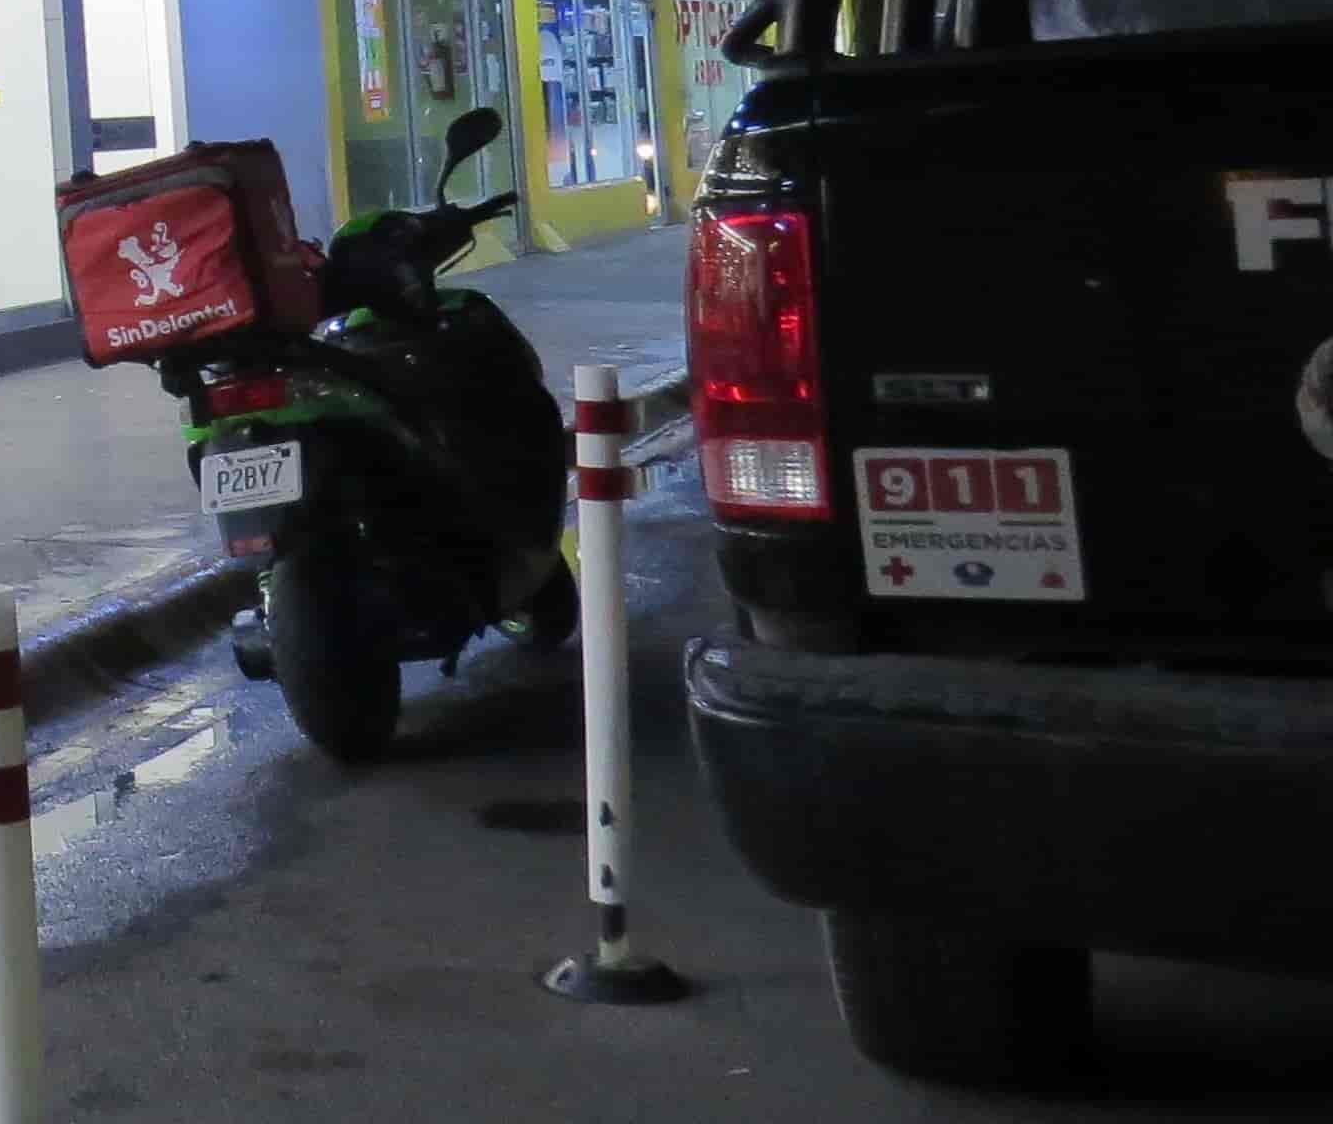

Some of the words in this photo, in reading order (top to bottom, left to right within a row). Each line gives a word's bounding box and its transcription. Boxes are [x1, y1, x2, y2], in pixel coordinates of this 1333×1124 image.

[1225, 176, 1333, 272] F
[217, 460, 283, 494] P2BY7
[879, 466, 1041, 506] 911
[873, 531, 1068, 552] EMERGENCIAS
